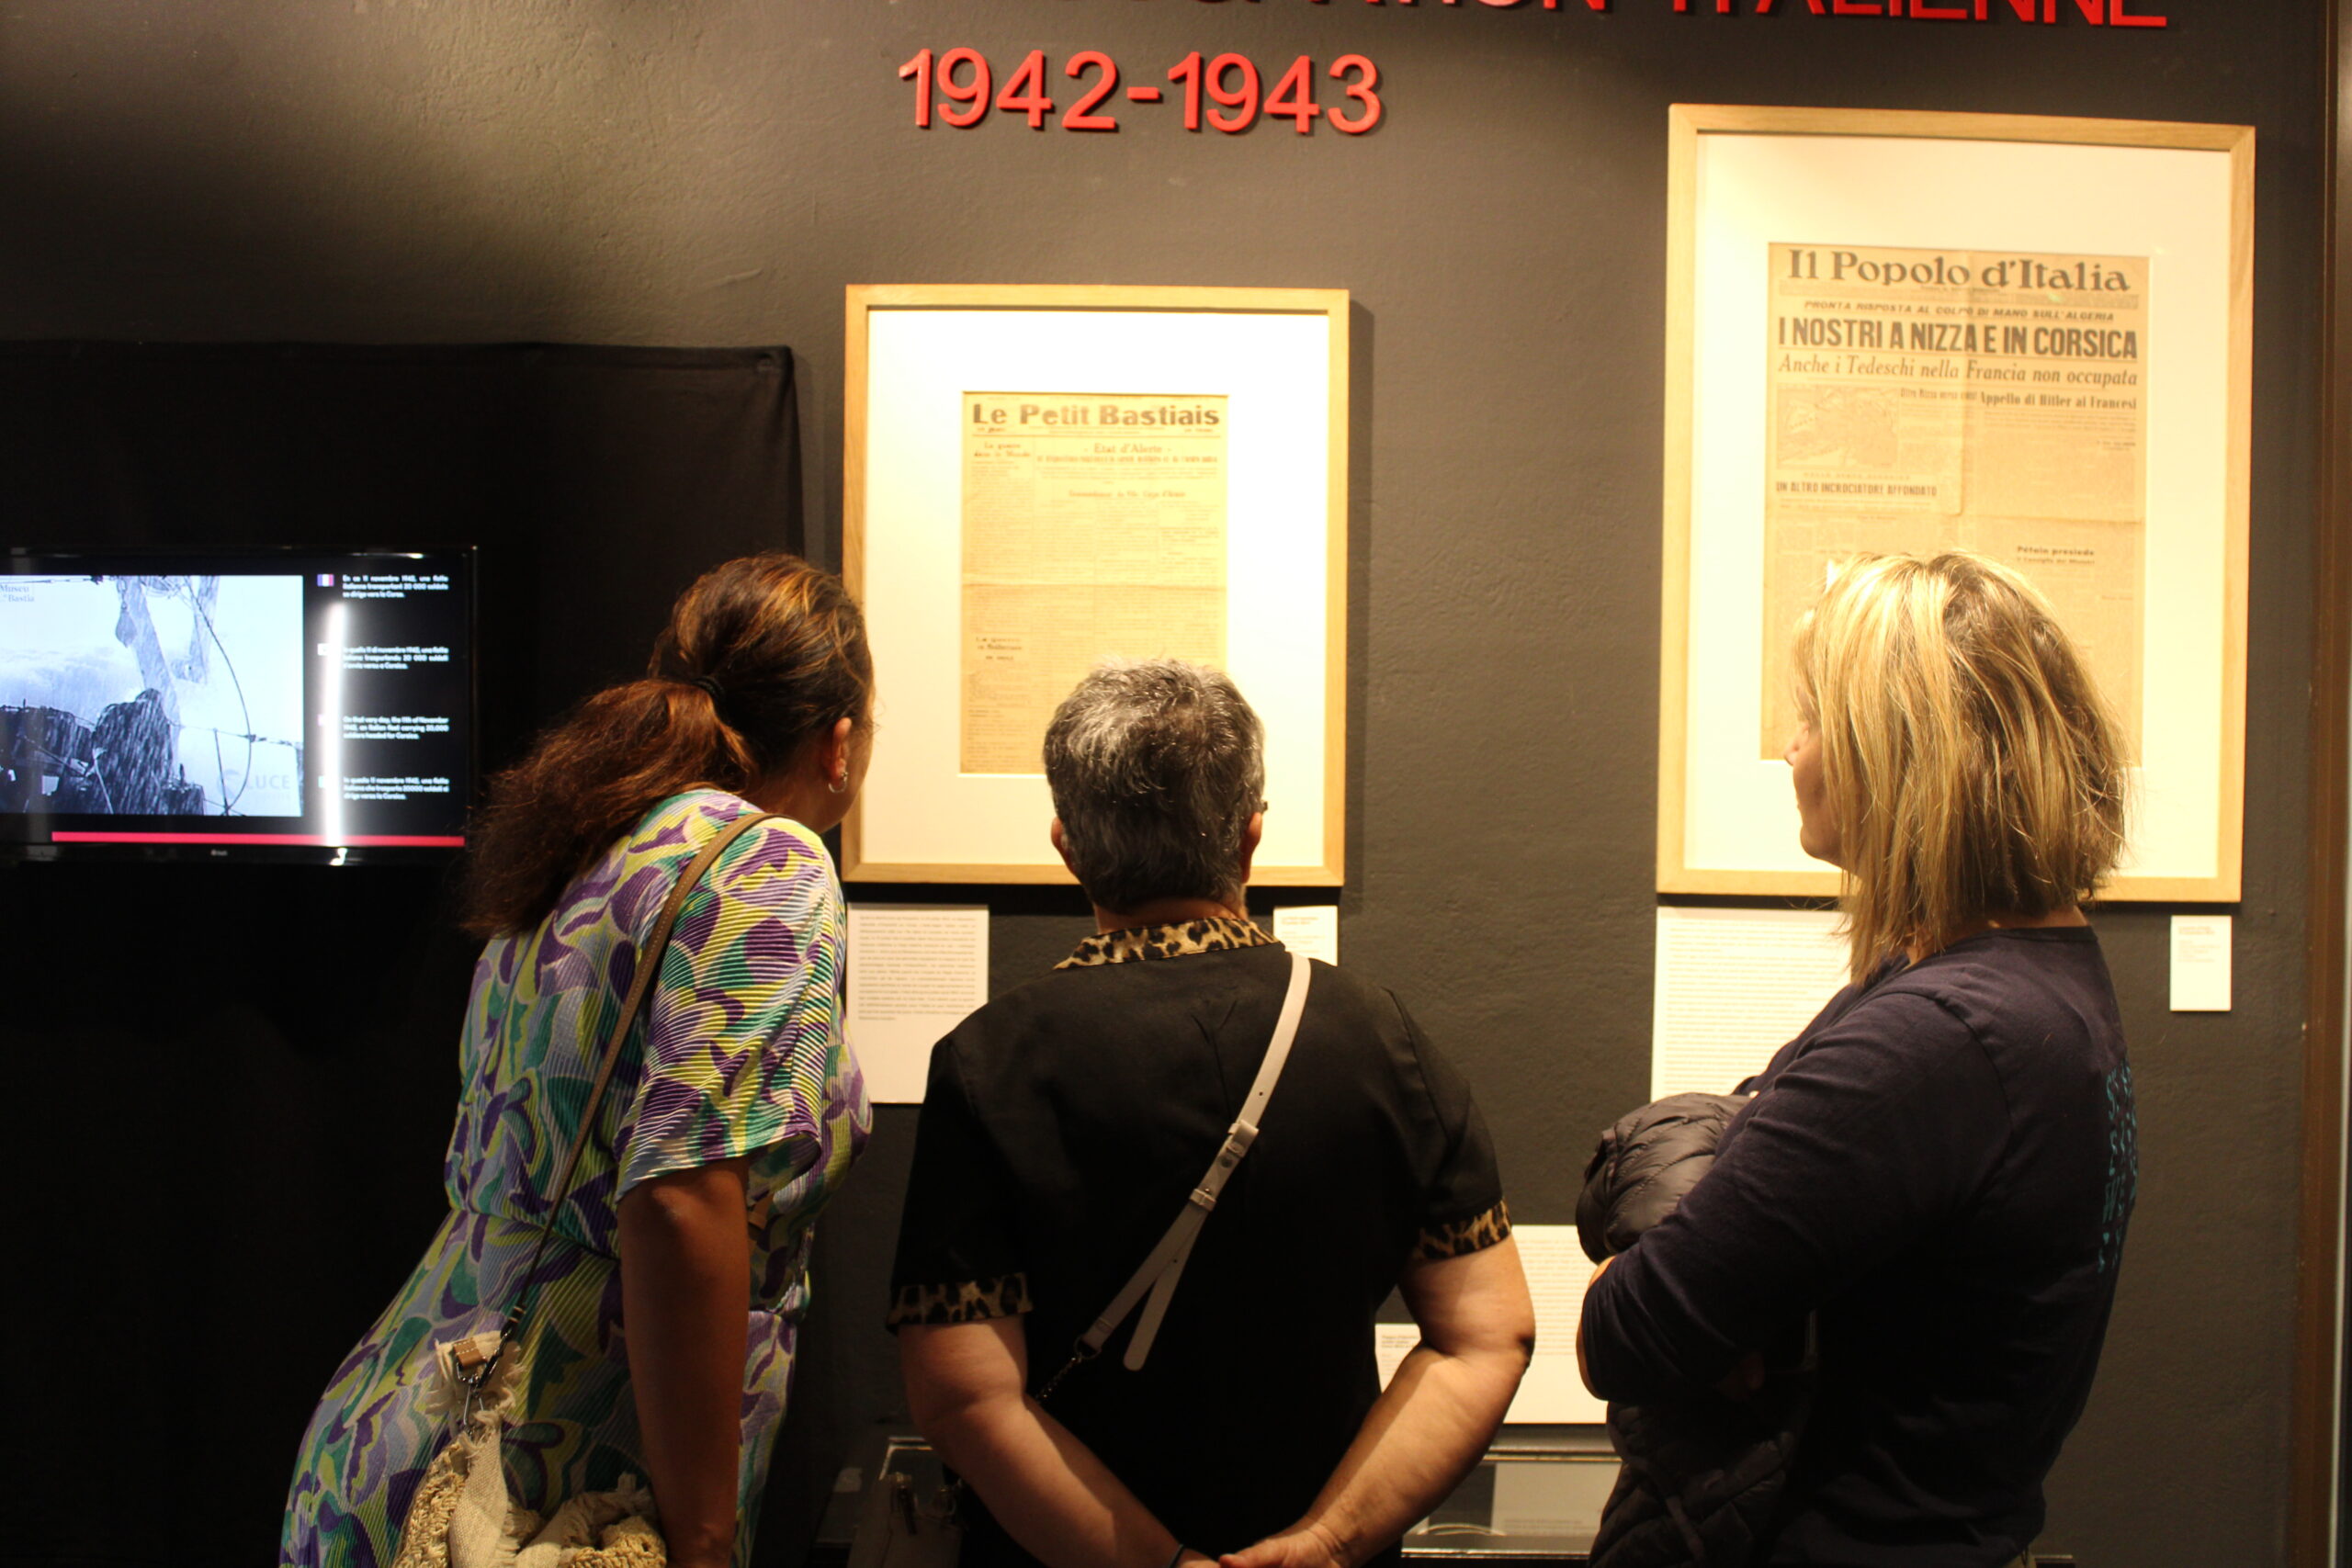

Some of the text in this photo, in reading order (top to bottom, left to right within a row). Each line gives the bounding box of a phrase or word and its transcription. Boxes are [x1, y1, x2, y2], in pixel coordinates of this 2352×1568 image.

[898, 47, 1381, 134] 1942-1943
[1789, 249, 2131, 292] Il Popolo d'Italia
[1804, 300, 1851, 310] PRONTA
[1856, 302, 1912, 313] RISPOSTA
[1918, 305, 1929, 314] AL
[1936, 305, 1973, 315] COLPO
[1977, 307, 1989, 316] DI
[1993, 308, 2028, 318] MANO
[1779, 317, 2138, 359] I NOSTRI A NIZZA E IN CORSICA
[1779, 353, 2138, 388] Anche i Tedeschi nella Francia non occupata
[973, 403, 1219, 426] Le Petit Bastiais
[1981, 392, 2021, 406] Appello
[2024, 393, 2036, 405] di
[2040, 393, 2071, 407] Hitler
[2090, 395, 2136, 410] Francesi
